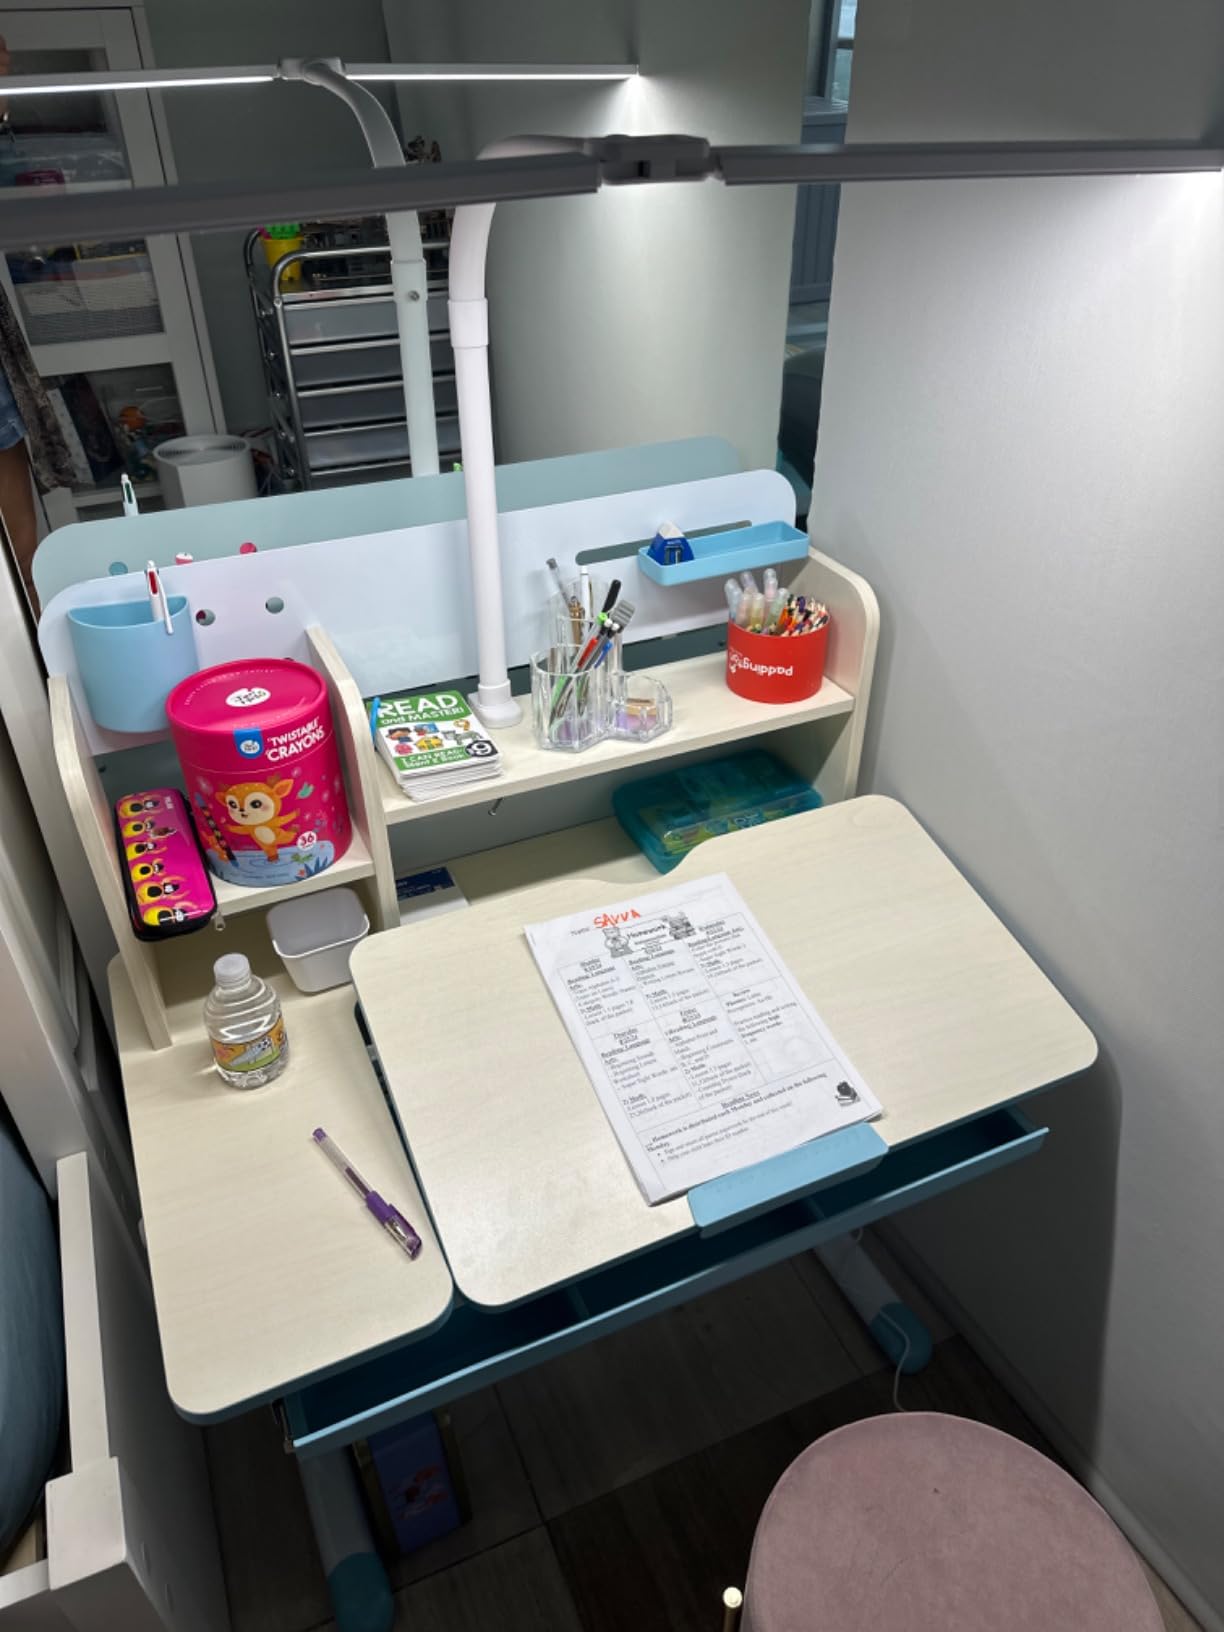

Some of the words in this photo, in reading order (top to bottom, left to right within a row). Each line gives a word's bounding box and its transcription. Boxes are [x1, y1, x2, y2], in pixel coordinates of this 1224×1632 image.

[377, 694, 458, 718] READ
[266, 727, 325, 761] CRAYONS
[300, 834, 315, 846] 36
[593, 909, 641, 929] SAVVA
